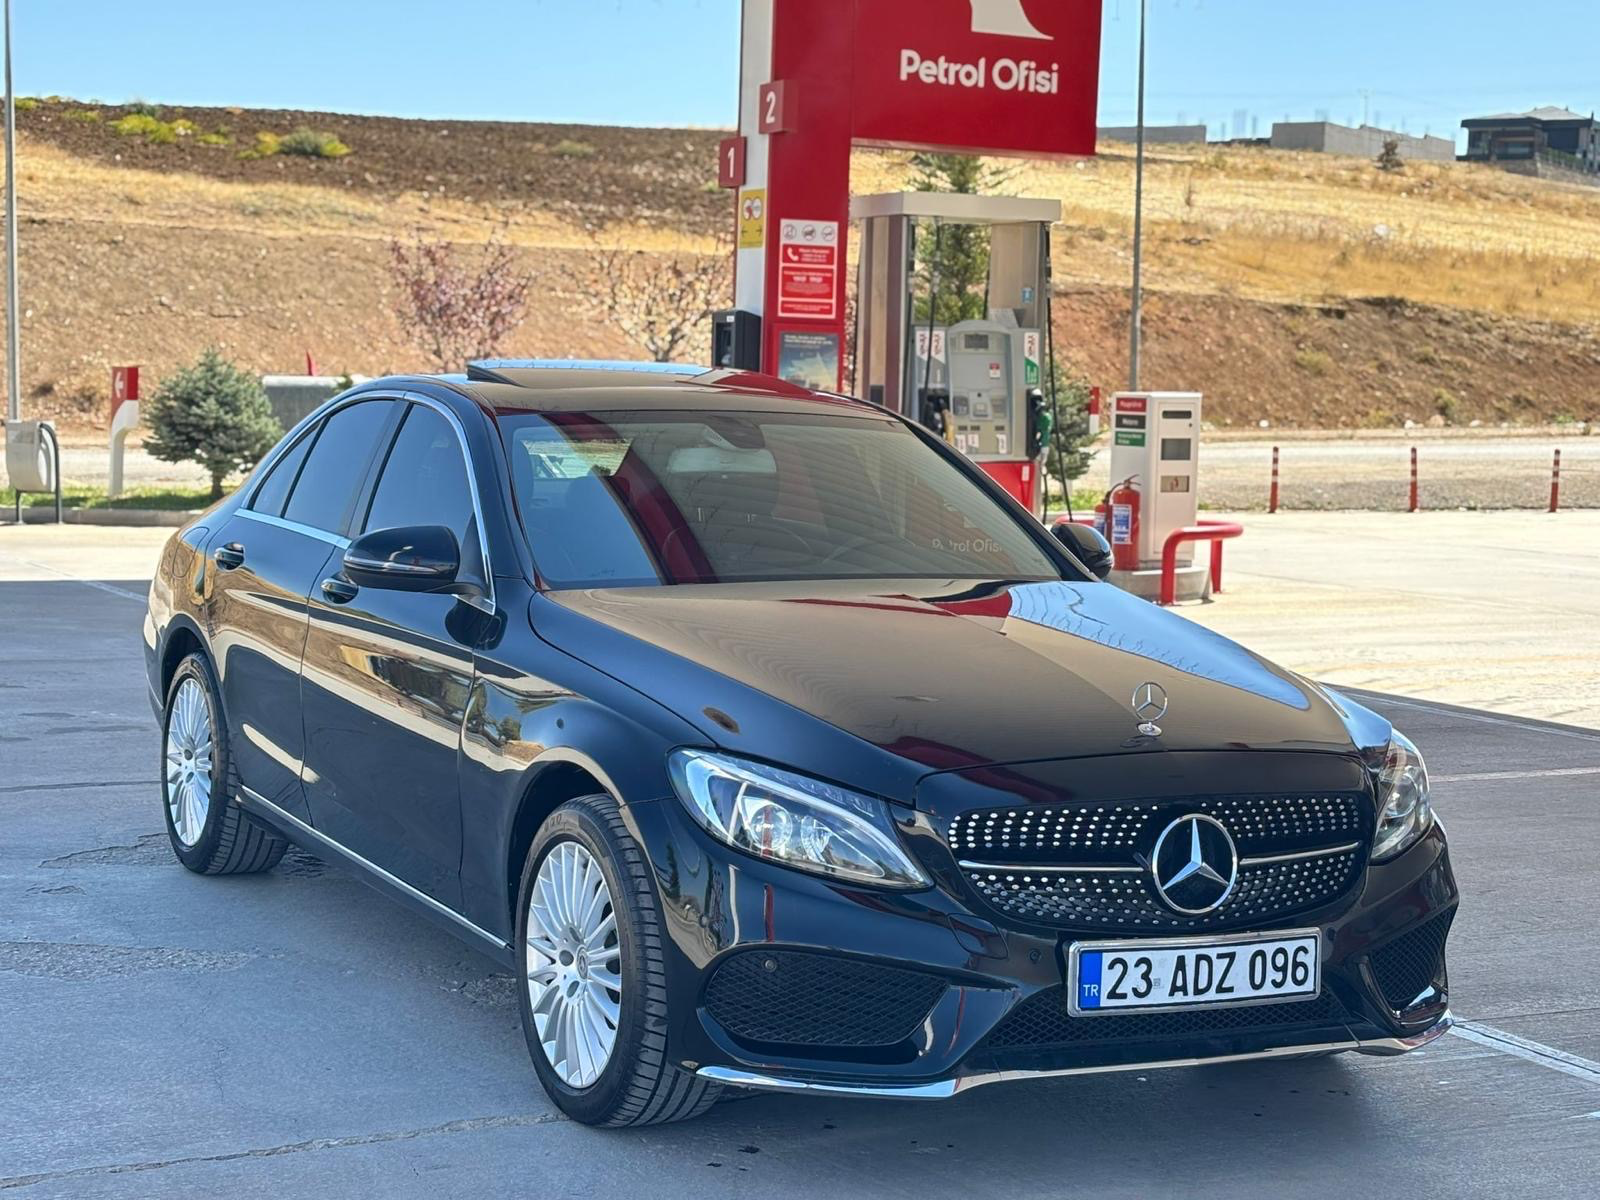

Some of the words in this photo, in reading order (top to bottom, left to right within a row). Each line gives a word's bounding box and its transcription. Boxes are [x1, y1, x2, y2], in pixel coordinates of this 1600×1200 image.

[900, 49, 985, 88] Petrol
[992, 58, 1058, 94] Ofisi
[764, 90, 777, 124] 2
[726, 147, 735, 178] 1
[1106, 957, 1153, 1000] 23
[1168, 951, 1237, 997] ADZ
[1249, 945, 1309, 991] 096
[1083, 984, 1099, 997] TR
